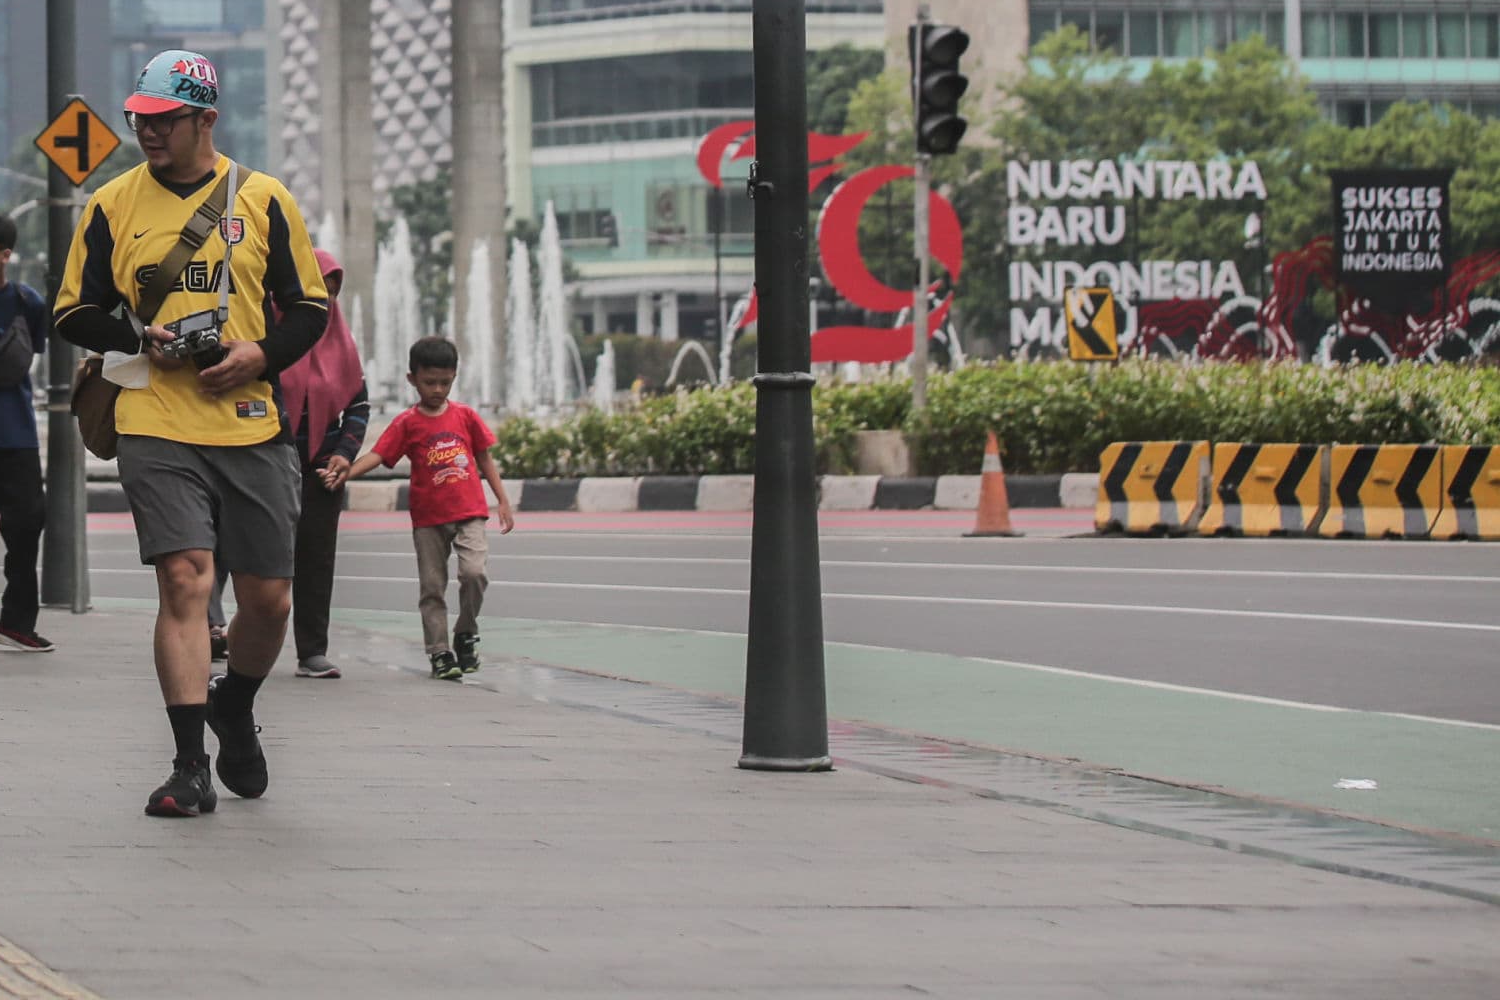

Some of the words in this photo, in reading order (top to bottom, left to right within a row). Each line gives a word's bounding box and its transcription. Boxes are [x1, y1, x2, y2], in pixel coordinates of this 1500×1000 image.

[1007, 160, 1267, 199] NUSANTARA
[1341, 187, 1443, 208] SUKSES
[1008, 205, 1126, 245] BARU
[1342, 210, 1442, 232] JAKARTA
[1342, 253, 1443, 271] INDONESIA
[1009, 260, 1245, 300] INDONESIA
